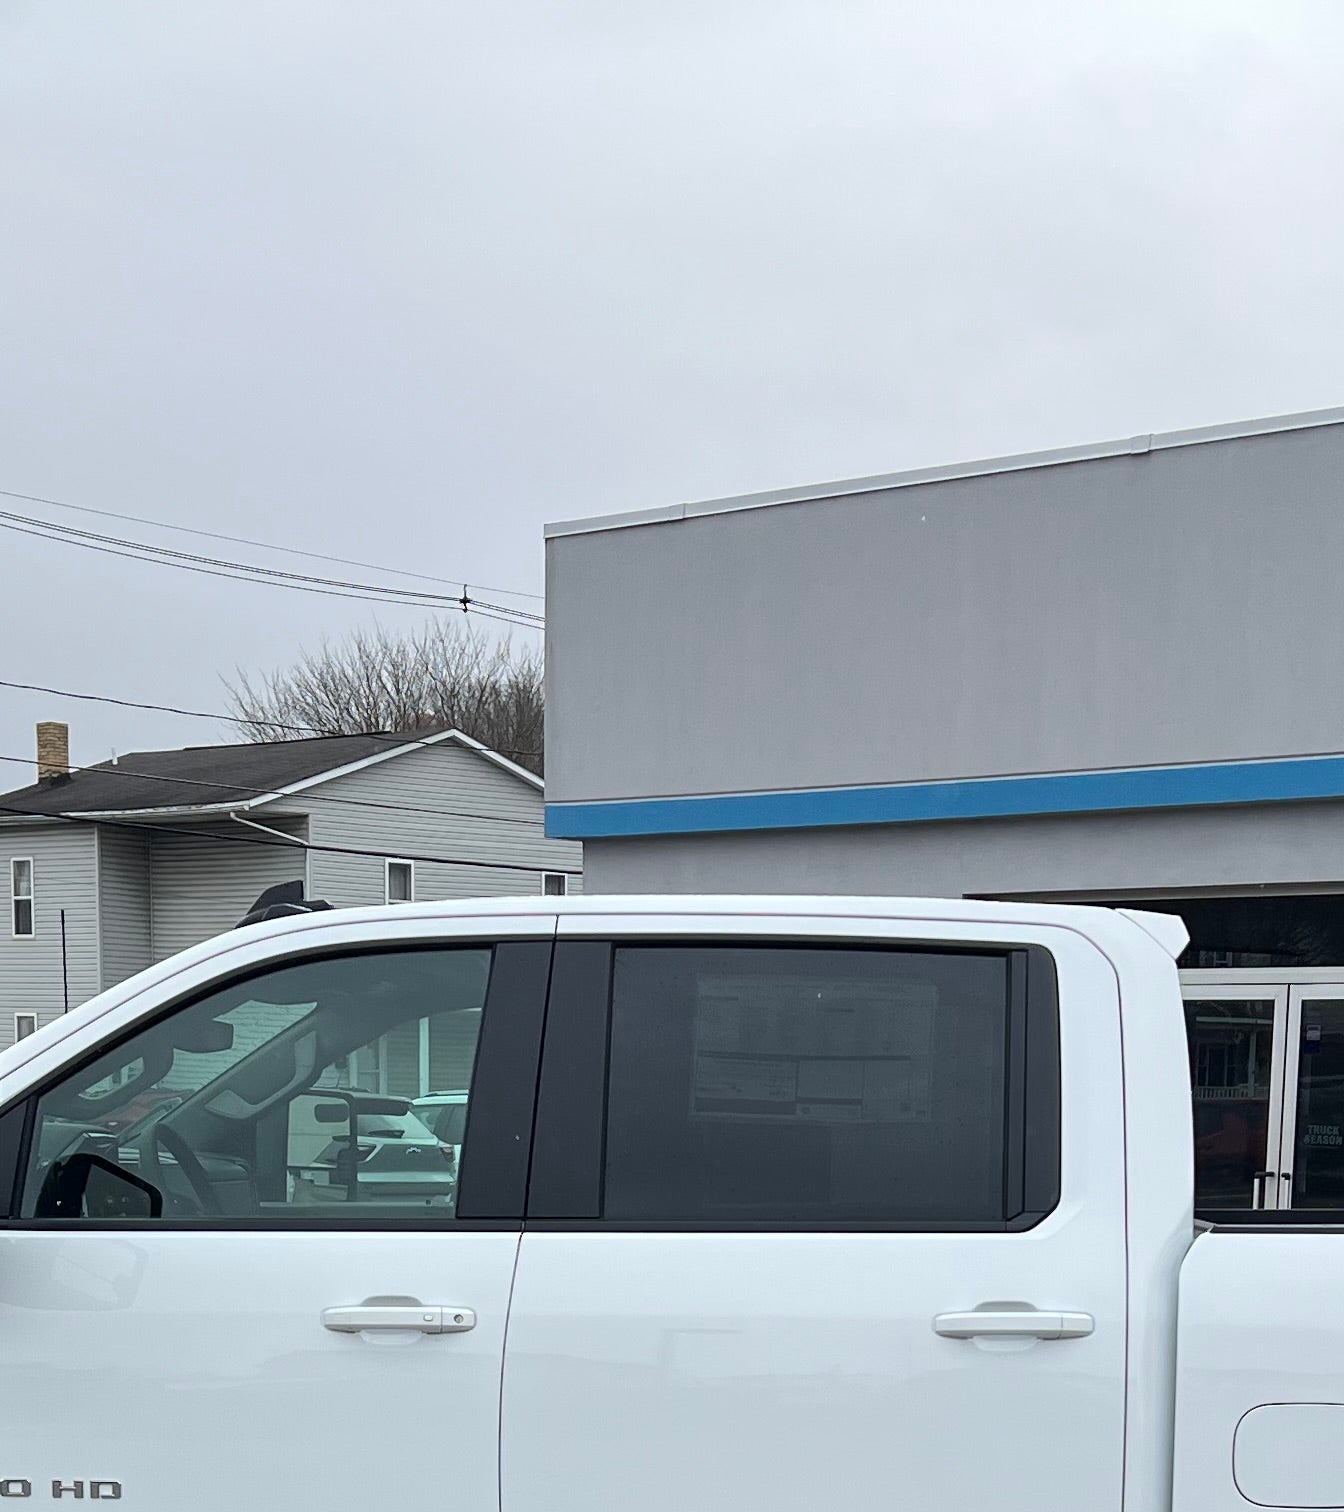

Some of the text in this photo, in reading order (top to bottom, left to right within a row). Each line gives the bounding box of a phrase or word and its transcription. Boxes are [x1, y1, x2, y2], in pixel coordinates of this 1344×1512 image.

[1307, 1124, 1340, 1135] TRUCK
[1303, 1135, 1343, 1145] SEASON
[51, 1480, 122, 1499] HD
